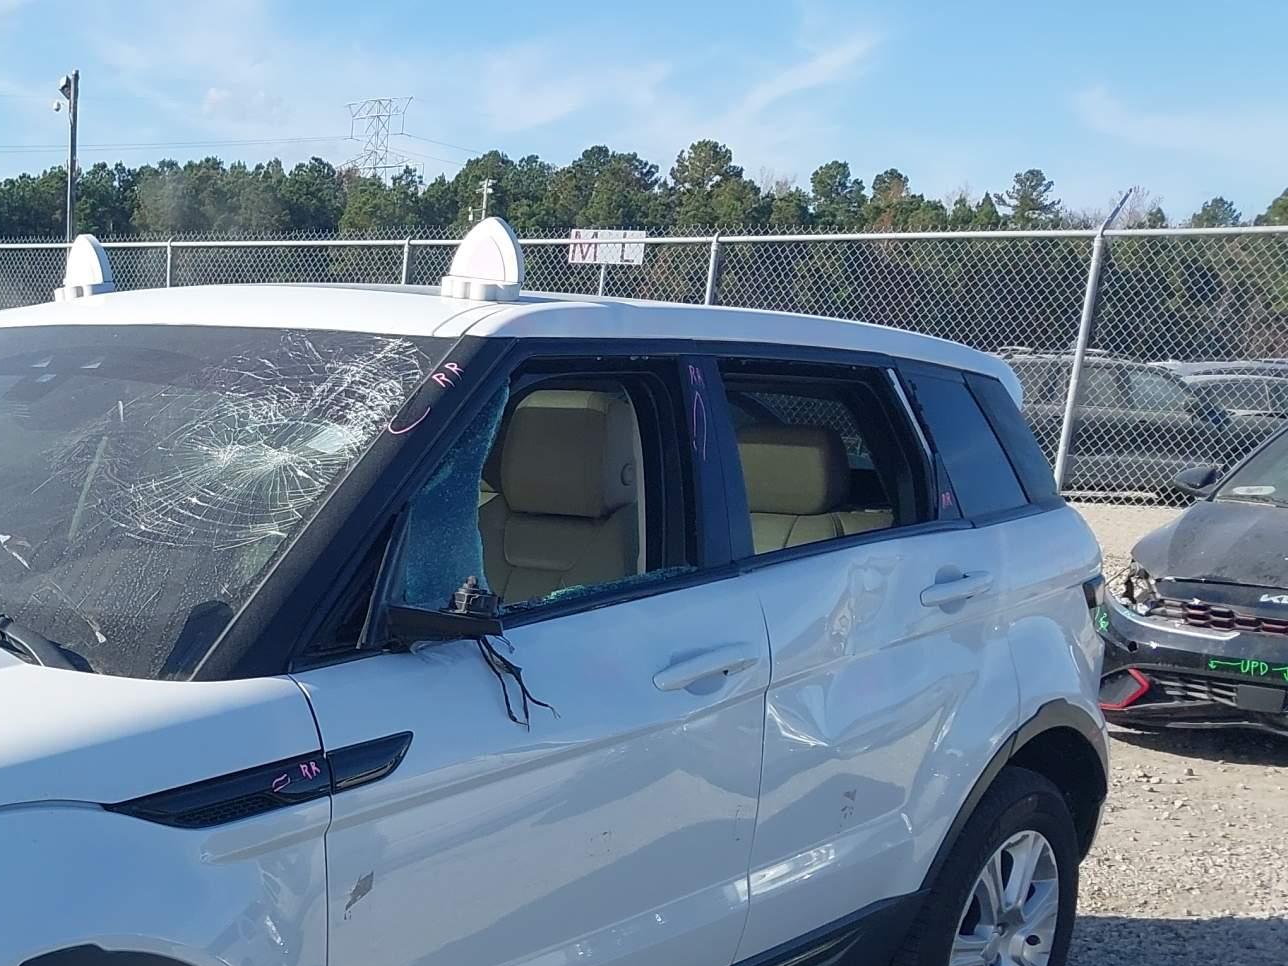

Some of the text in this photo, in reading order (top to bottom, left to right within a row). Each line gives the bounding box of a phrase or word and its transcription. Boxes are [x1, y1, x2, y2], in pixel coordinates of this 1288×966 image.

[571, 231, 635, 262] M L
[432, 362, 465, 388] RR
[1240, 660, 1269, 675] UPD
[299, 761, 321, 780] RR
